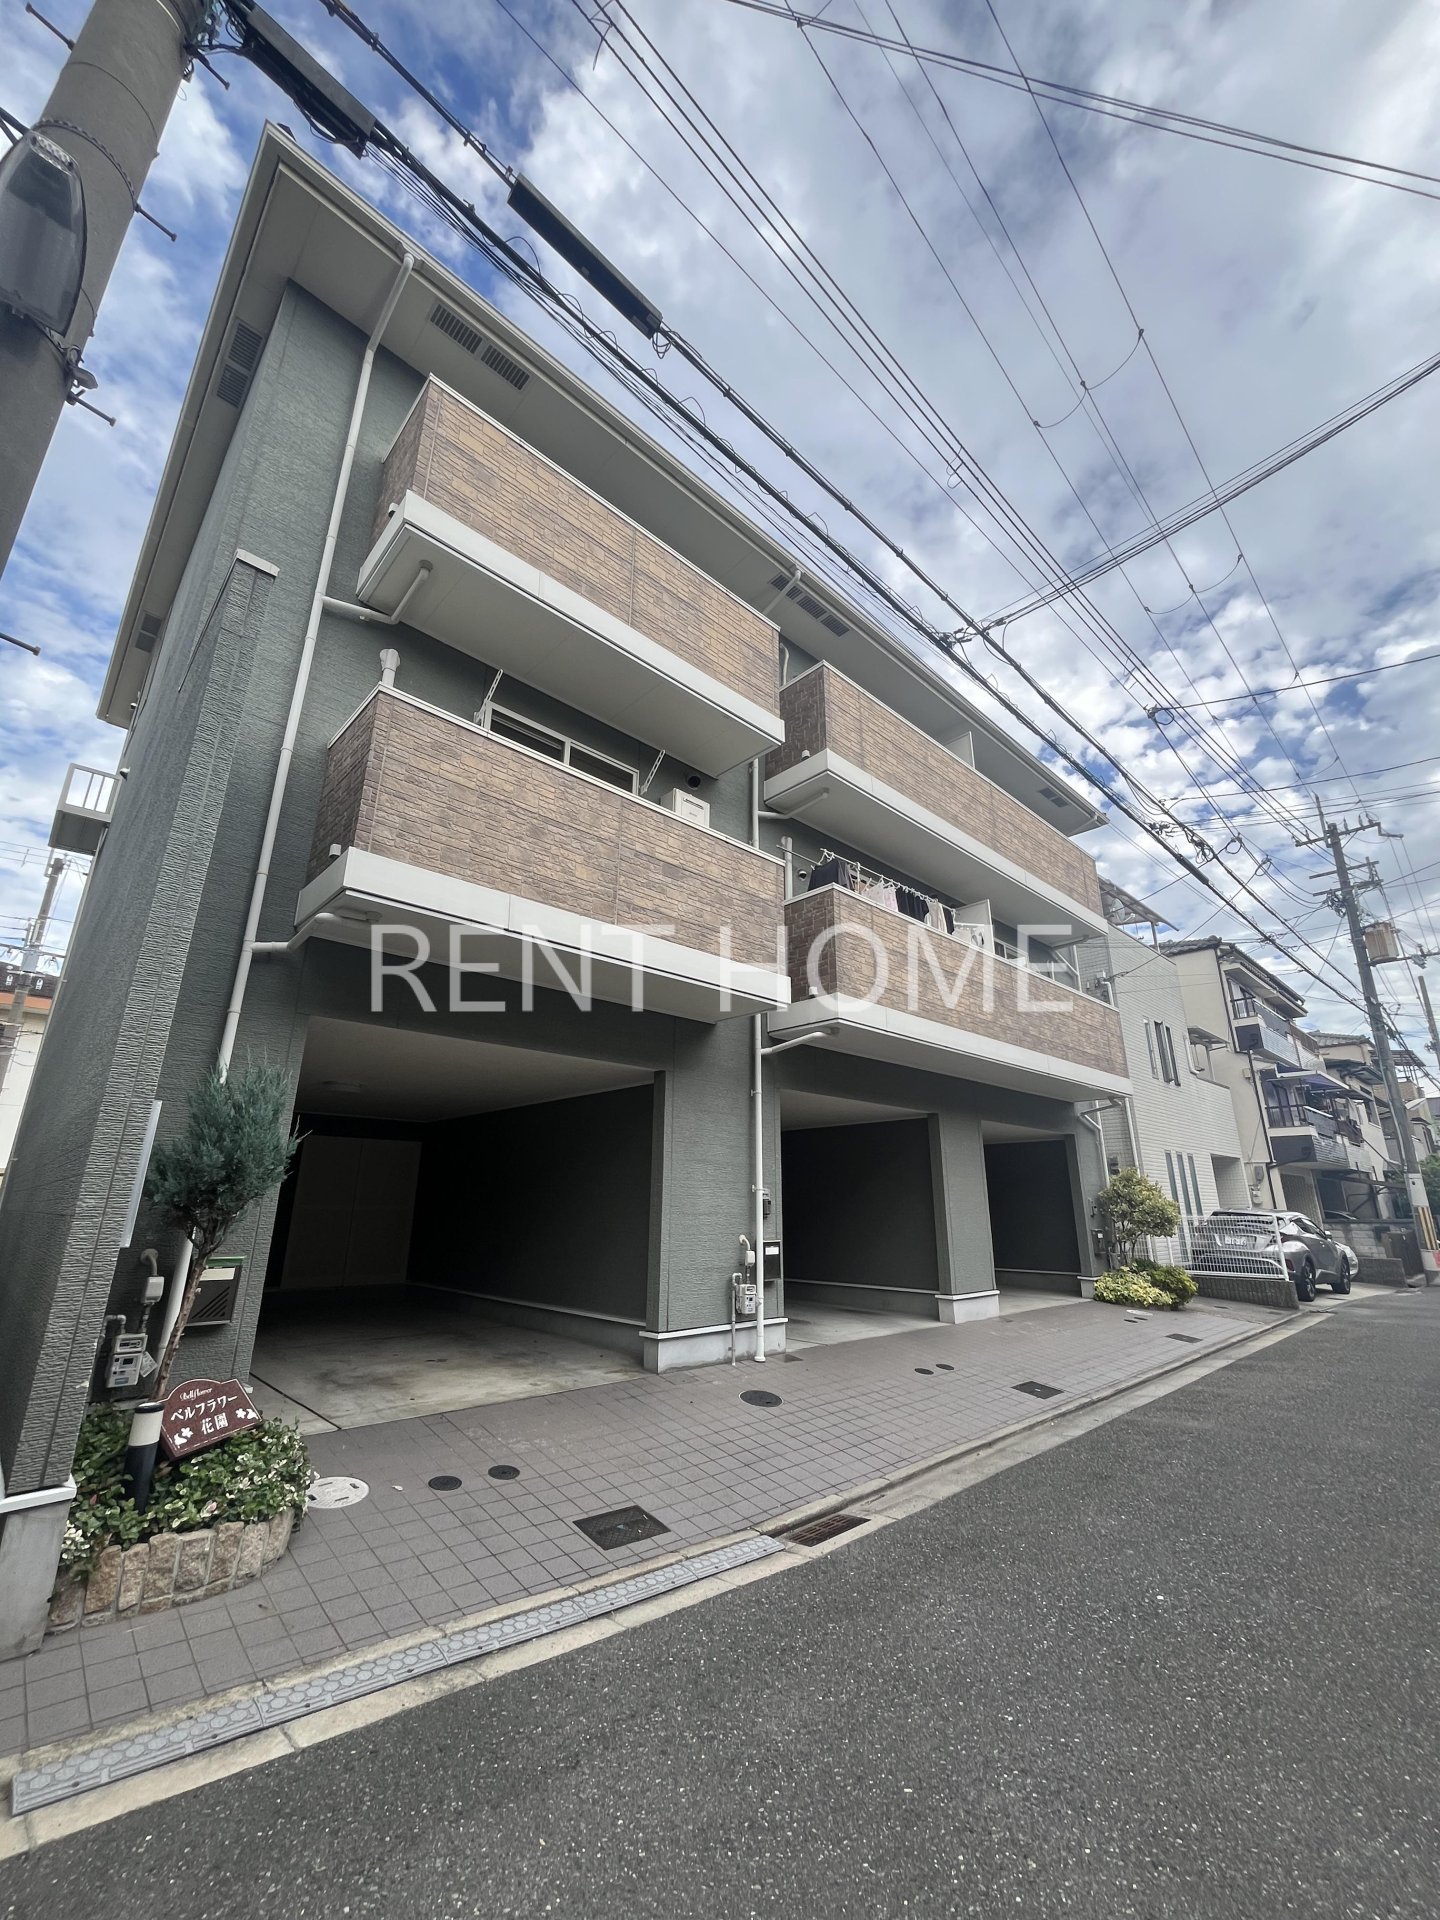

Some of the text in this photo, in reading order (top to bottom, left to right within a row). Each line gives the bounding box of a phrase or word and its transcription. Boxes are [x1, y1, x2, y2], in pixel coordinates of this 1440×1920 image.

[171, 1396, 238, 1420] ベルフラワー
[202, 1413, 228, 1434] 花園
